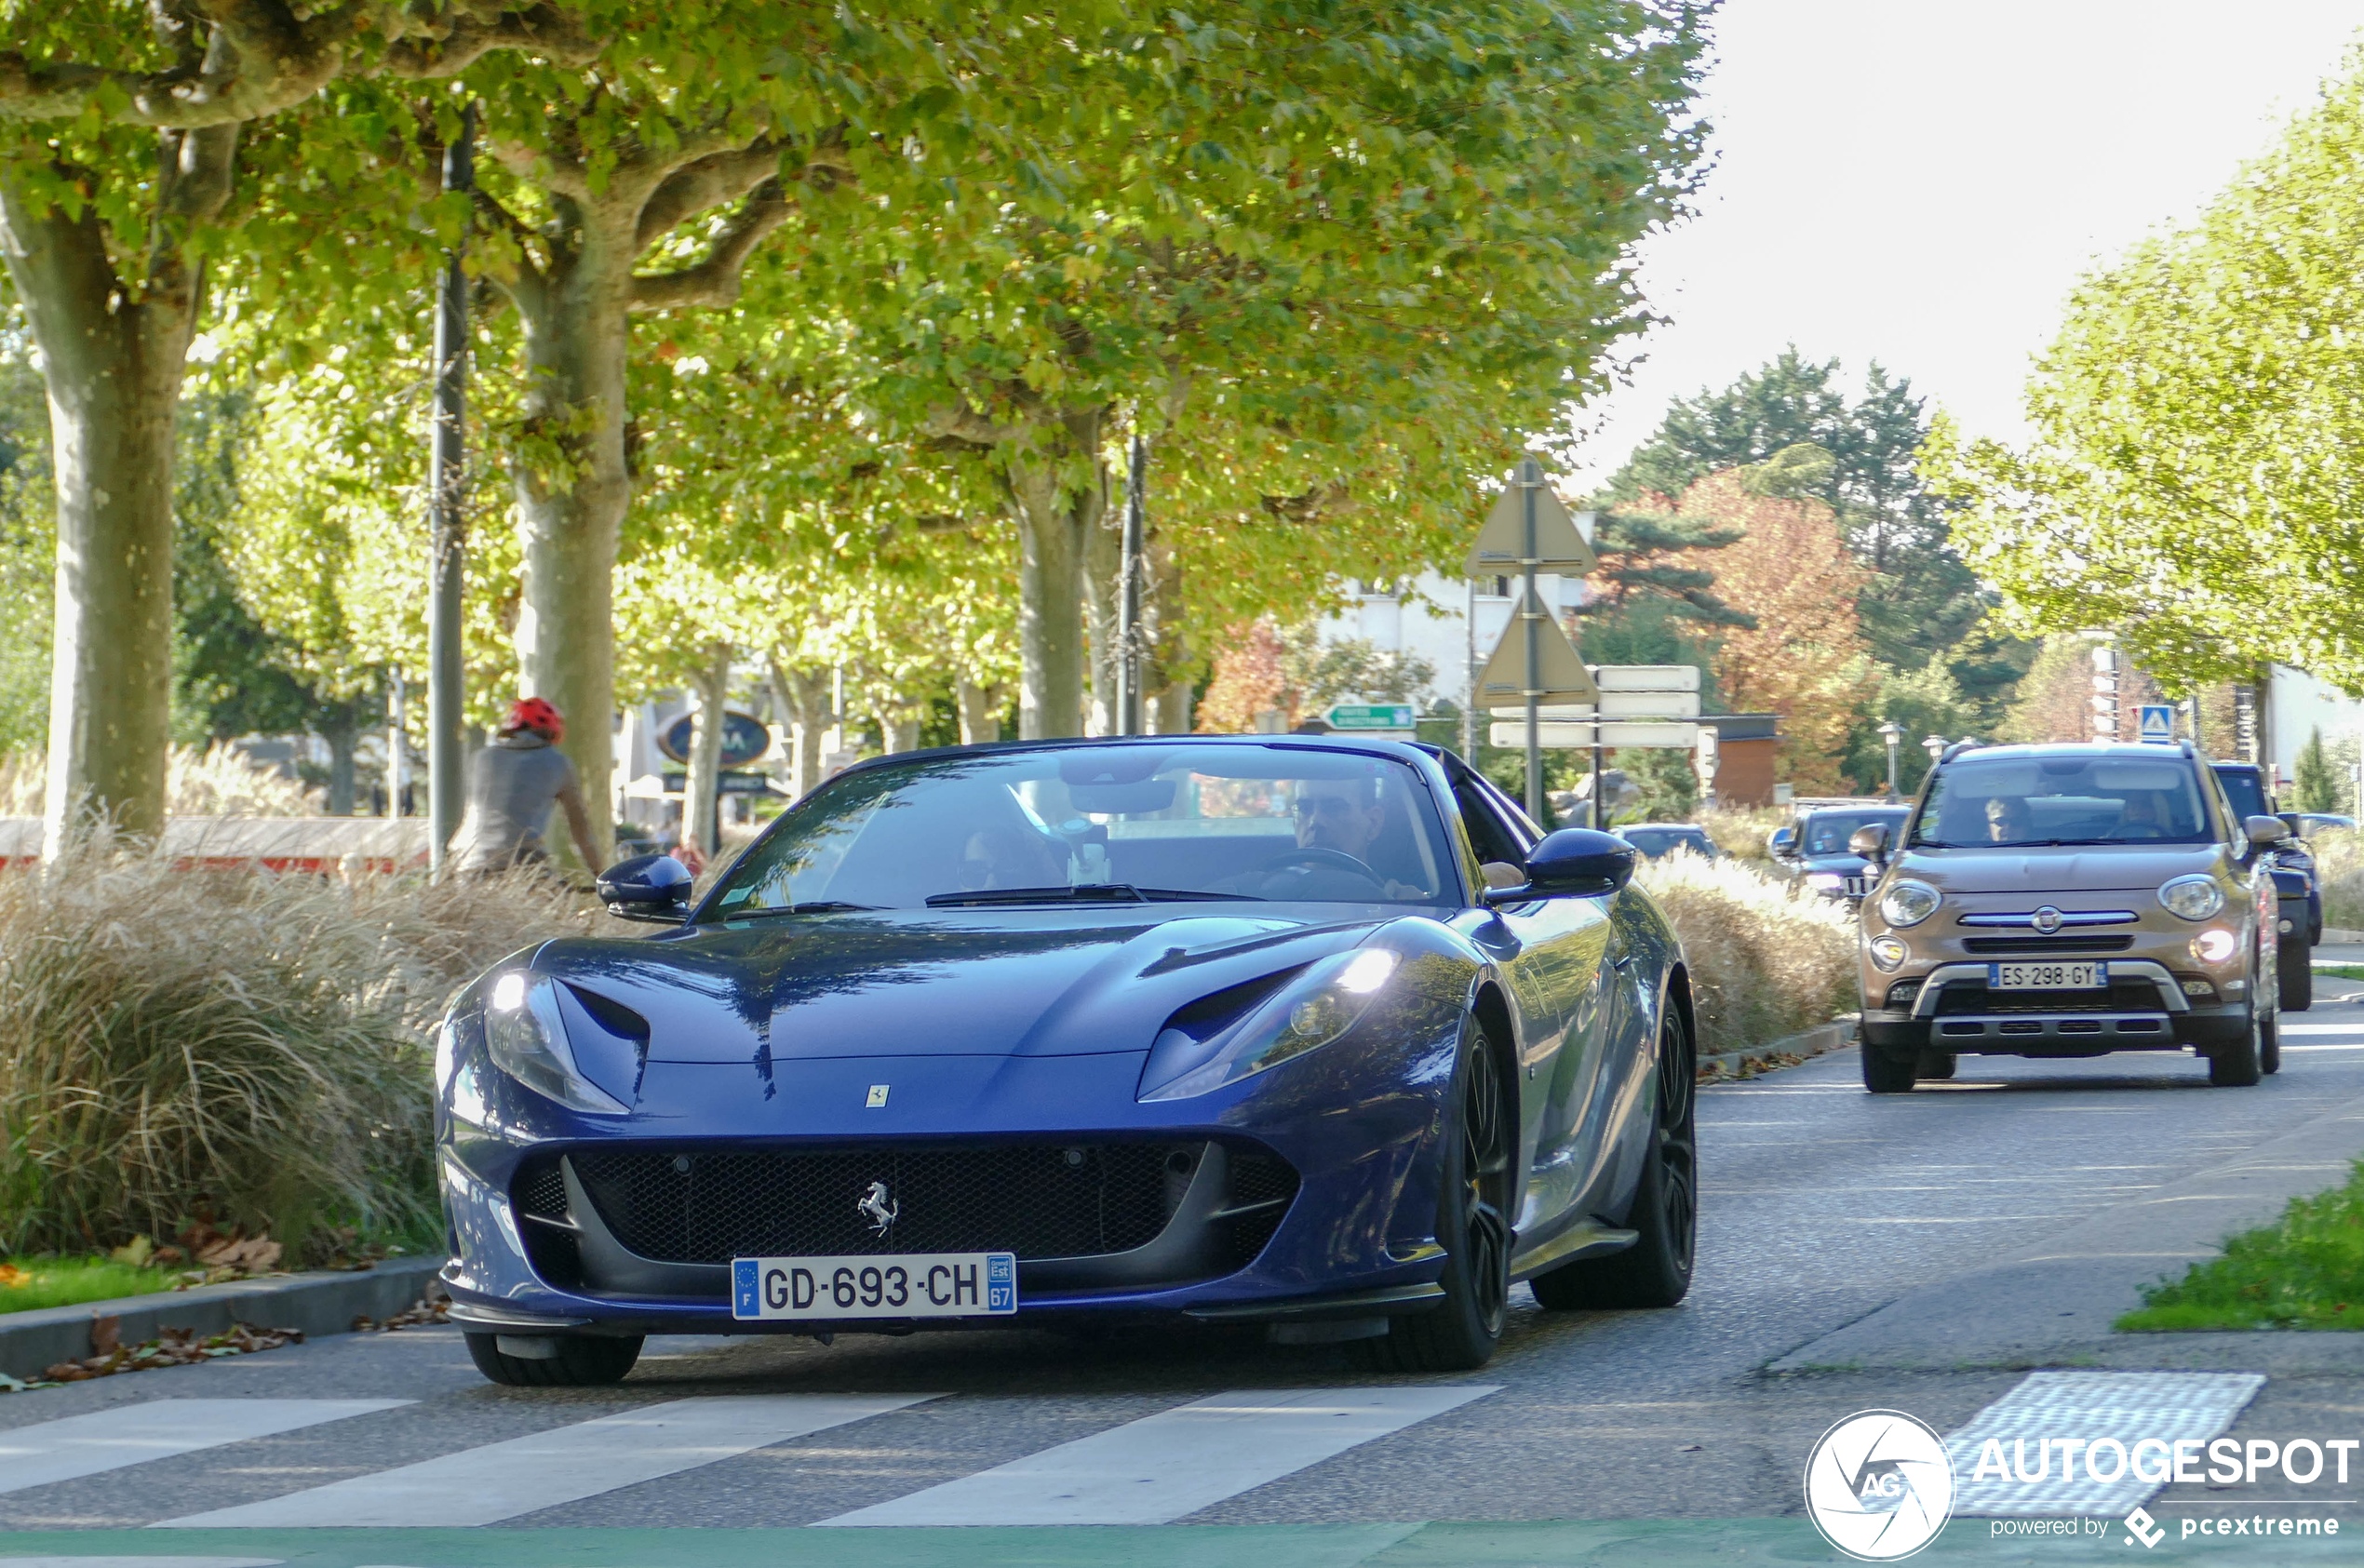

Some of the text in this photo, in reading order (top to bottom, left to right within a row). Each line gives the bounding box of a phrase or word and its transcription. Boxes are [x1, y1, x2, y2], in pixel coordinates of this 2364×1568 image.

[2002, 966, 2093, 985] ES-298-GY
[990, 1266, 1009, 1277] Est
[765, 1264, 979, 1309] GD-693-CH
[743, 1293, 751, 1307] F
[990, 1287, 1011, 1307] 67
